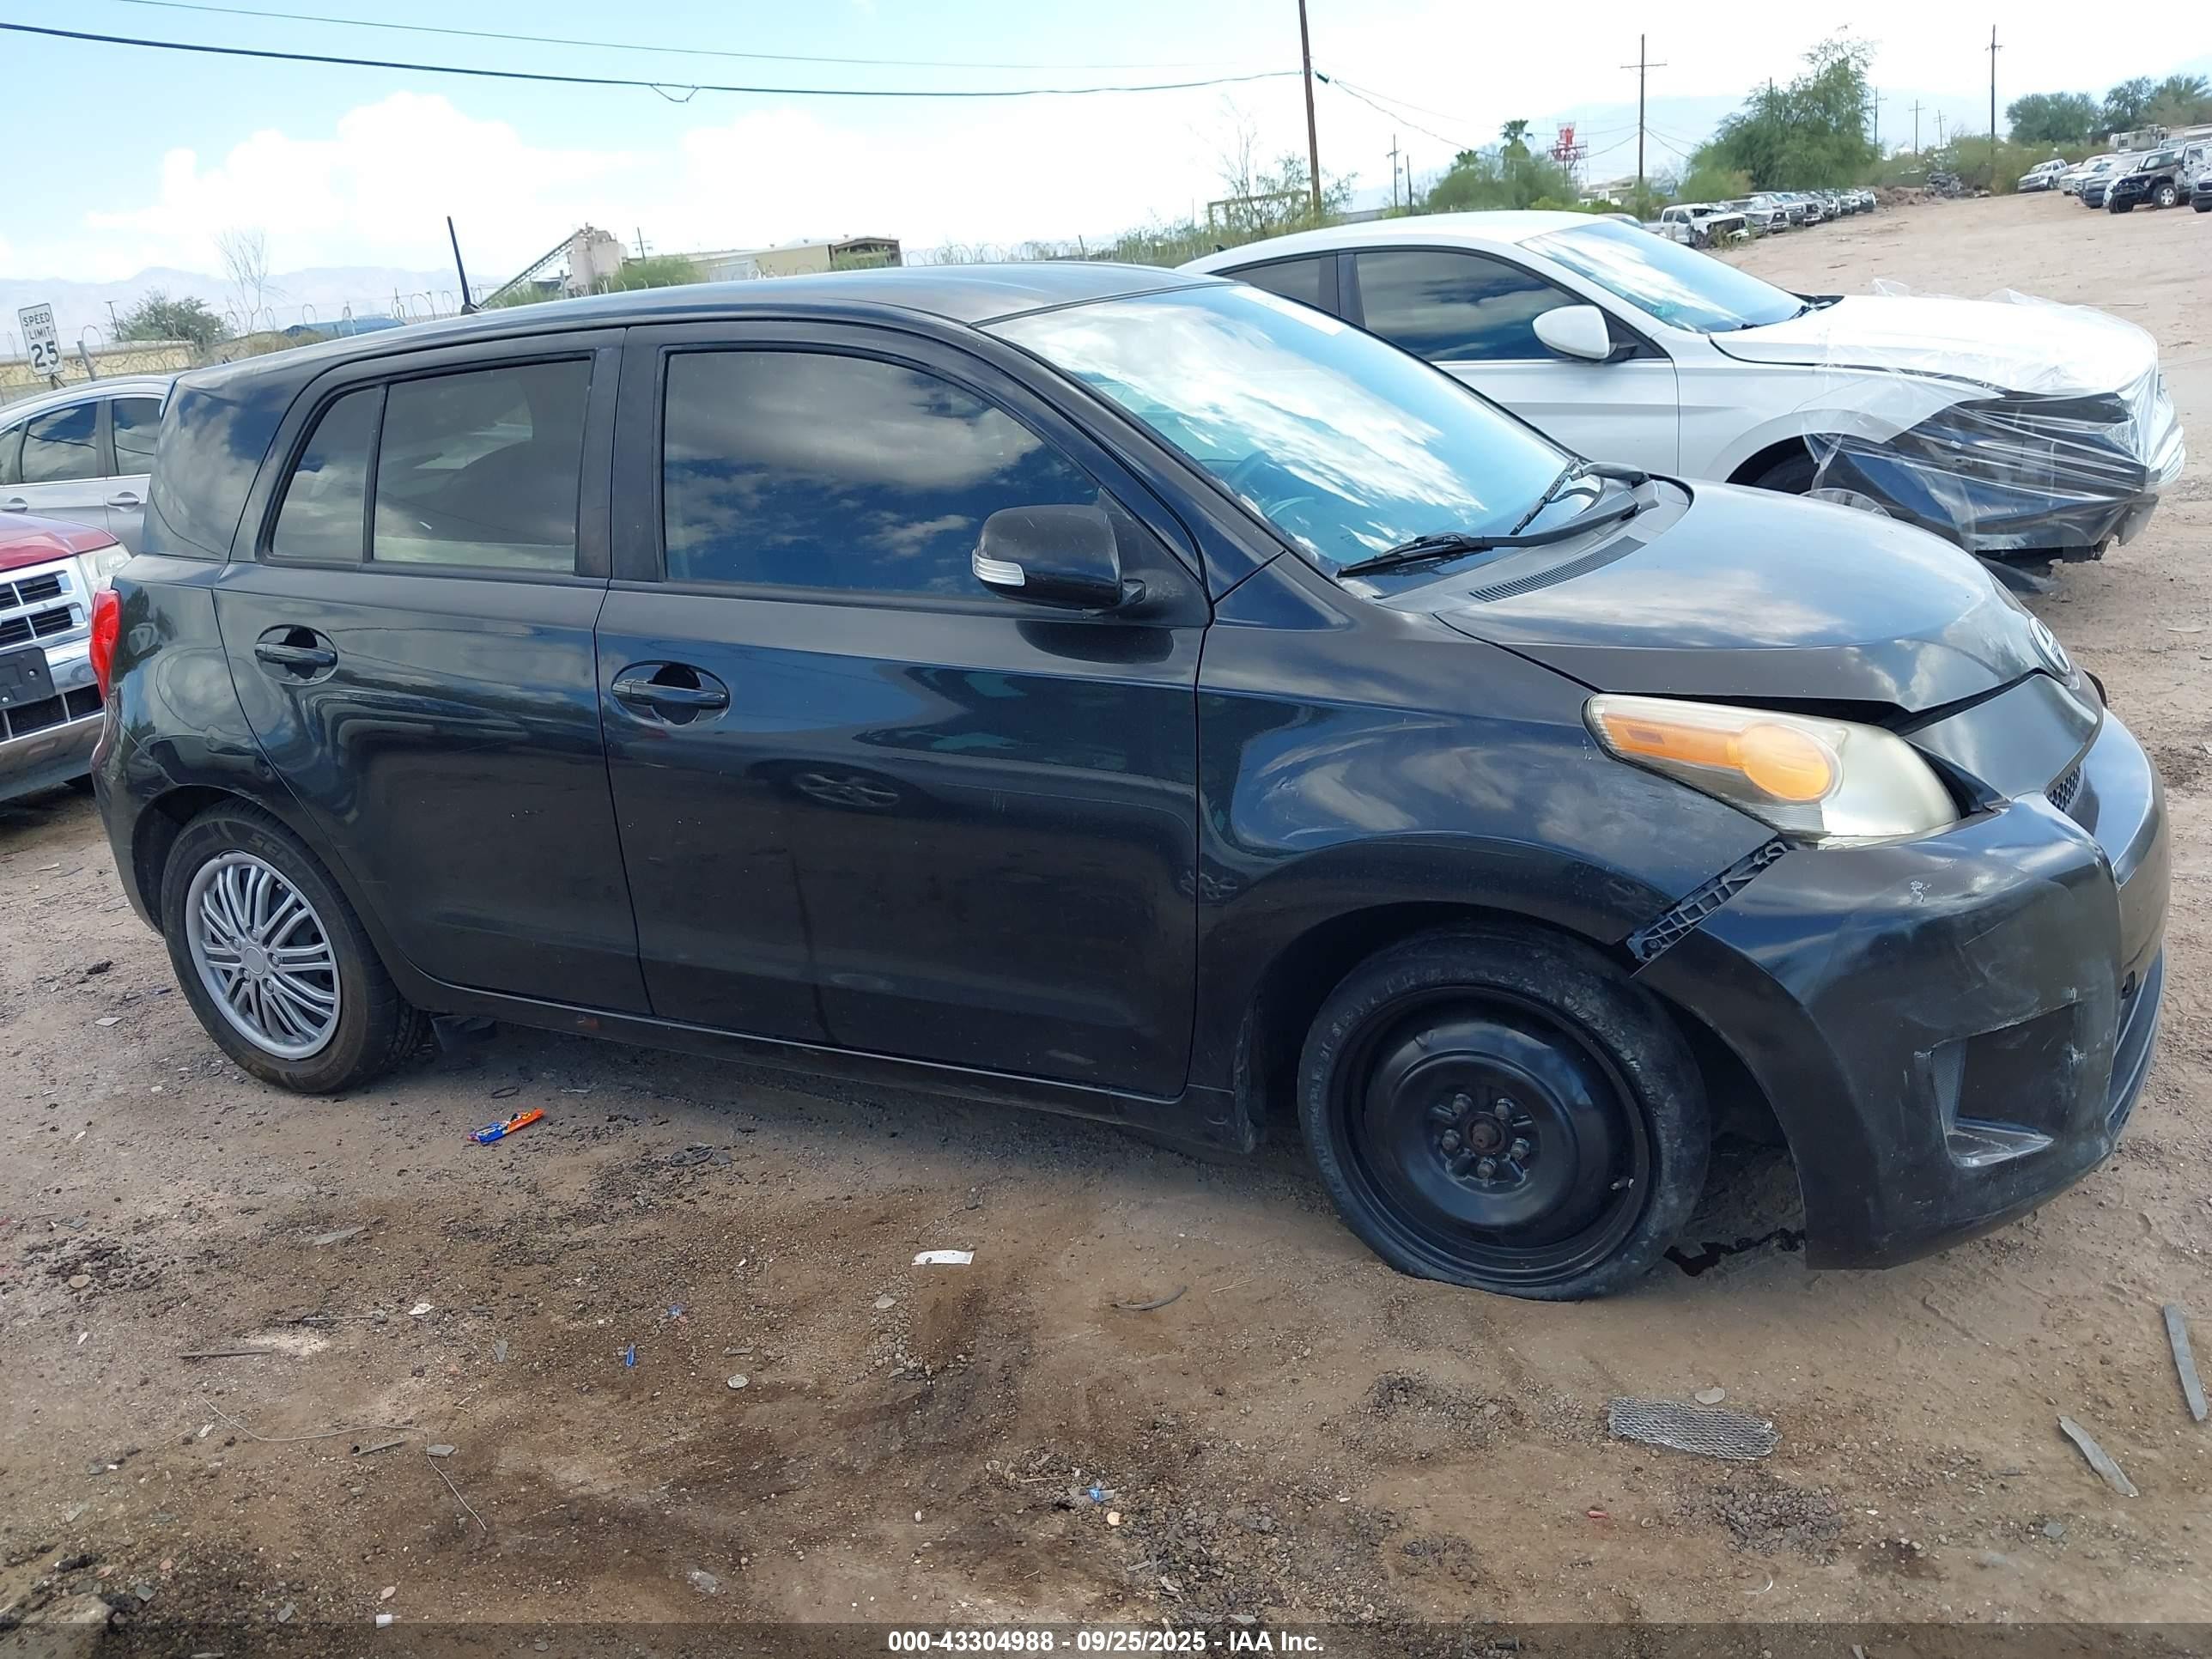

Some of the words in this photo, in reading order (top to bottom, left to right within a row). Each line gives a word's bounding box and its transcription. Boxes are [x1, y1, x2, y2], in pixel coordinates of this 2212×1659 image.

[23, 313, 50, 326] SPEED
[29, 327, 51, 339] LIMIT
[31, 341, 59, 368] 25
